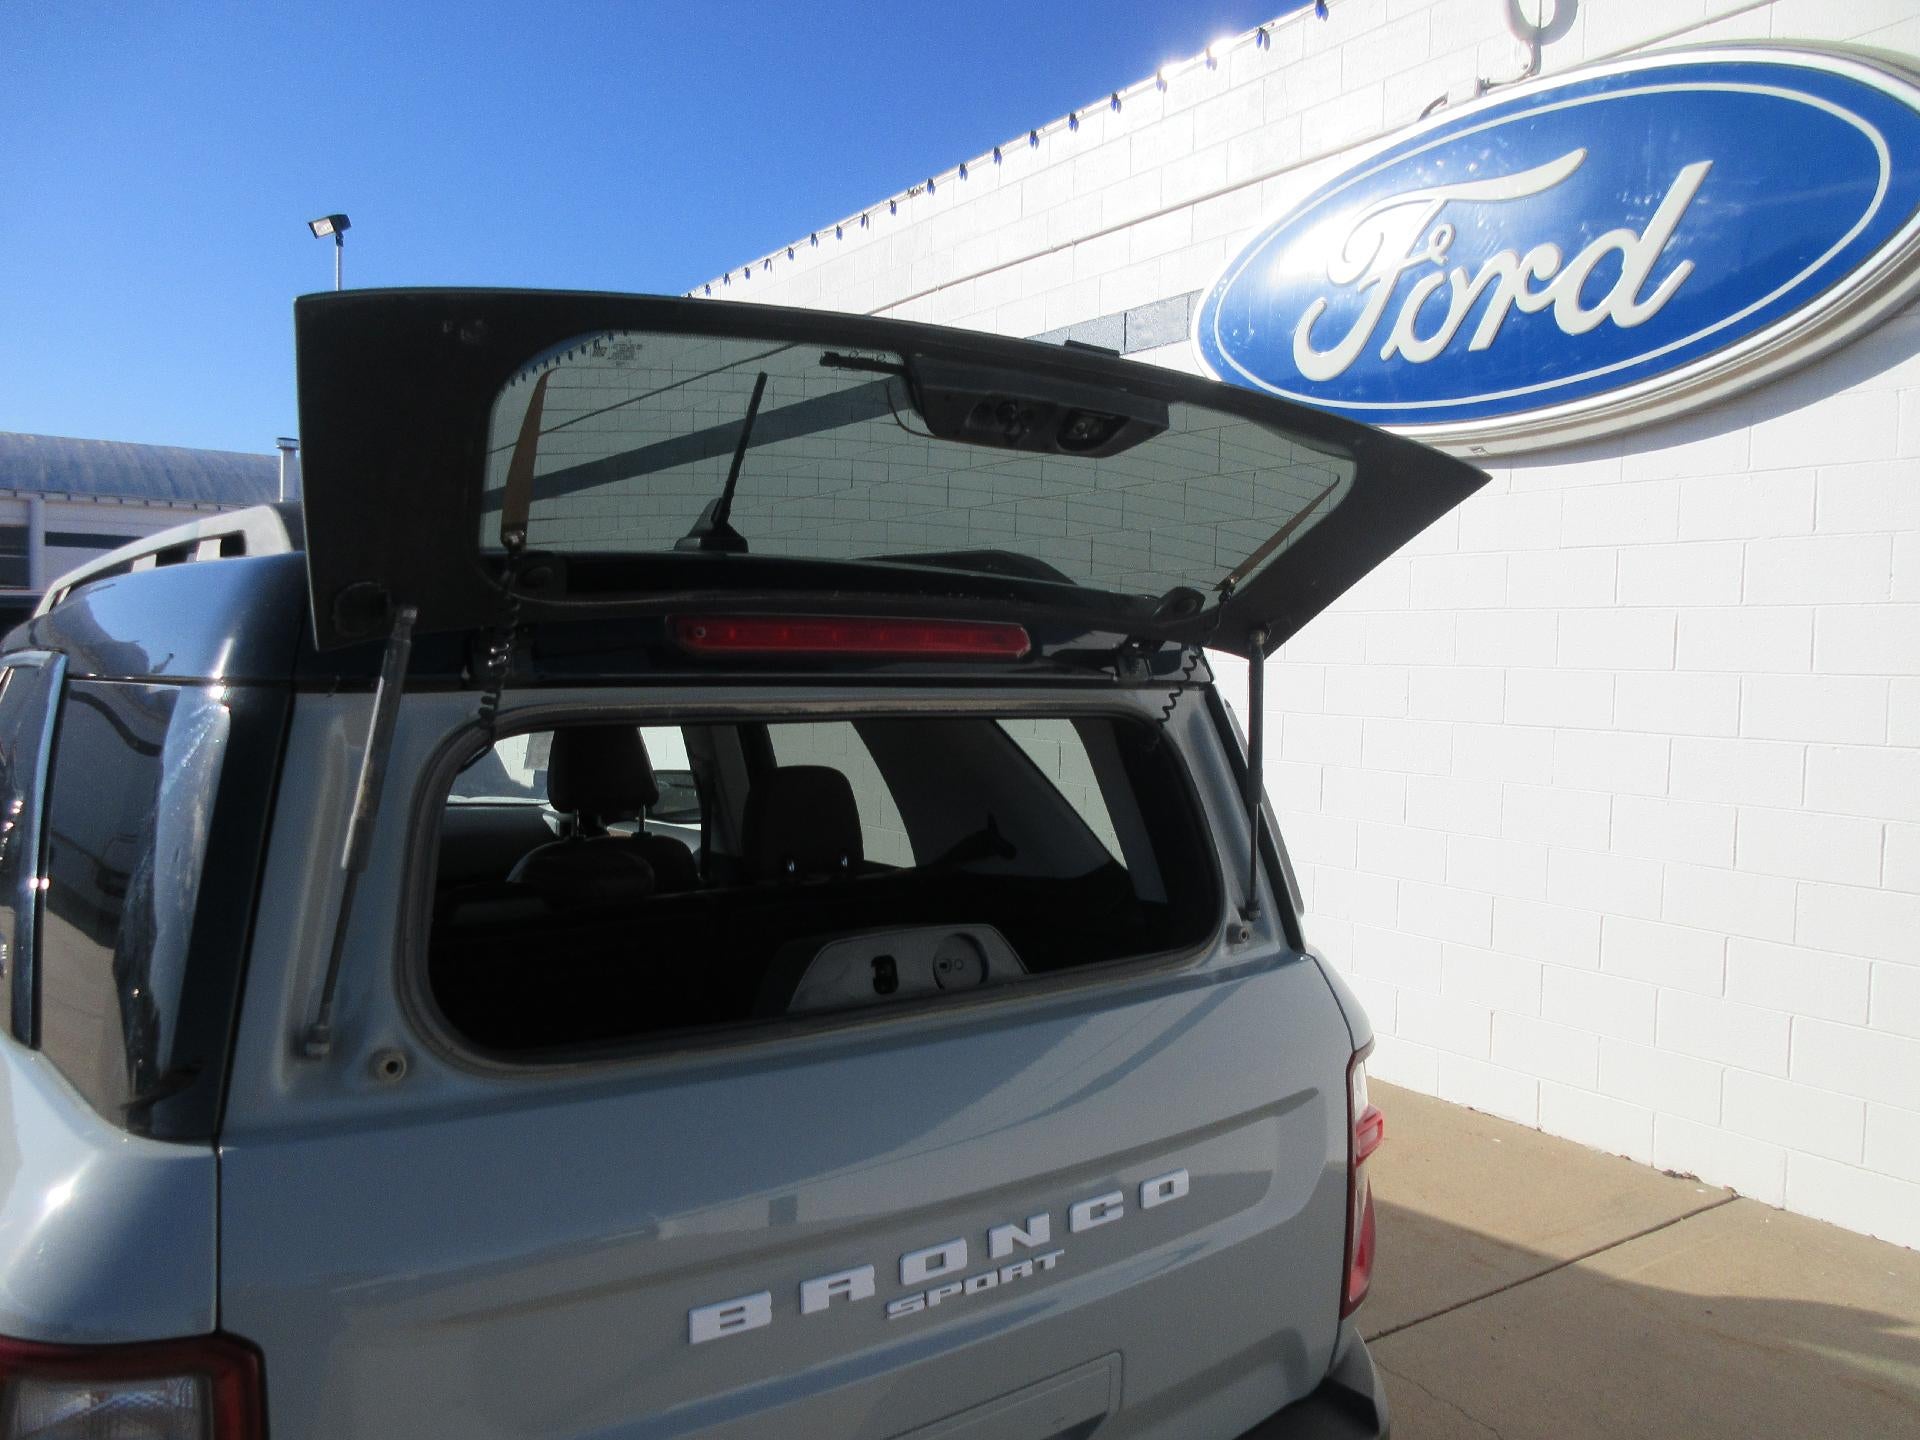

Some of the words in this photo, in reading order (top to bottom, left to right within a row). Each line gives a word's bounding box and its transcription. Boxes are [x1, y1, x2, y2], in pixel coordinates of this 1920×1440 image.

[1292, 147, 1714, 381] Ford
[688, 1168, 1190, 1344] BRONCO
[886, 1249, 1065, 1320] SPORT
